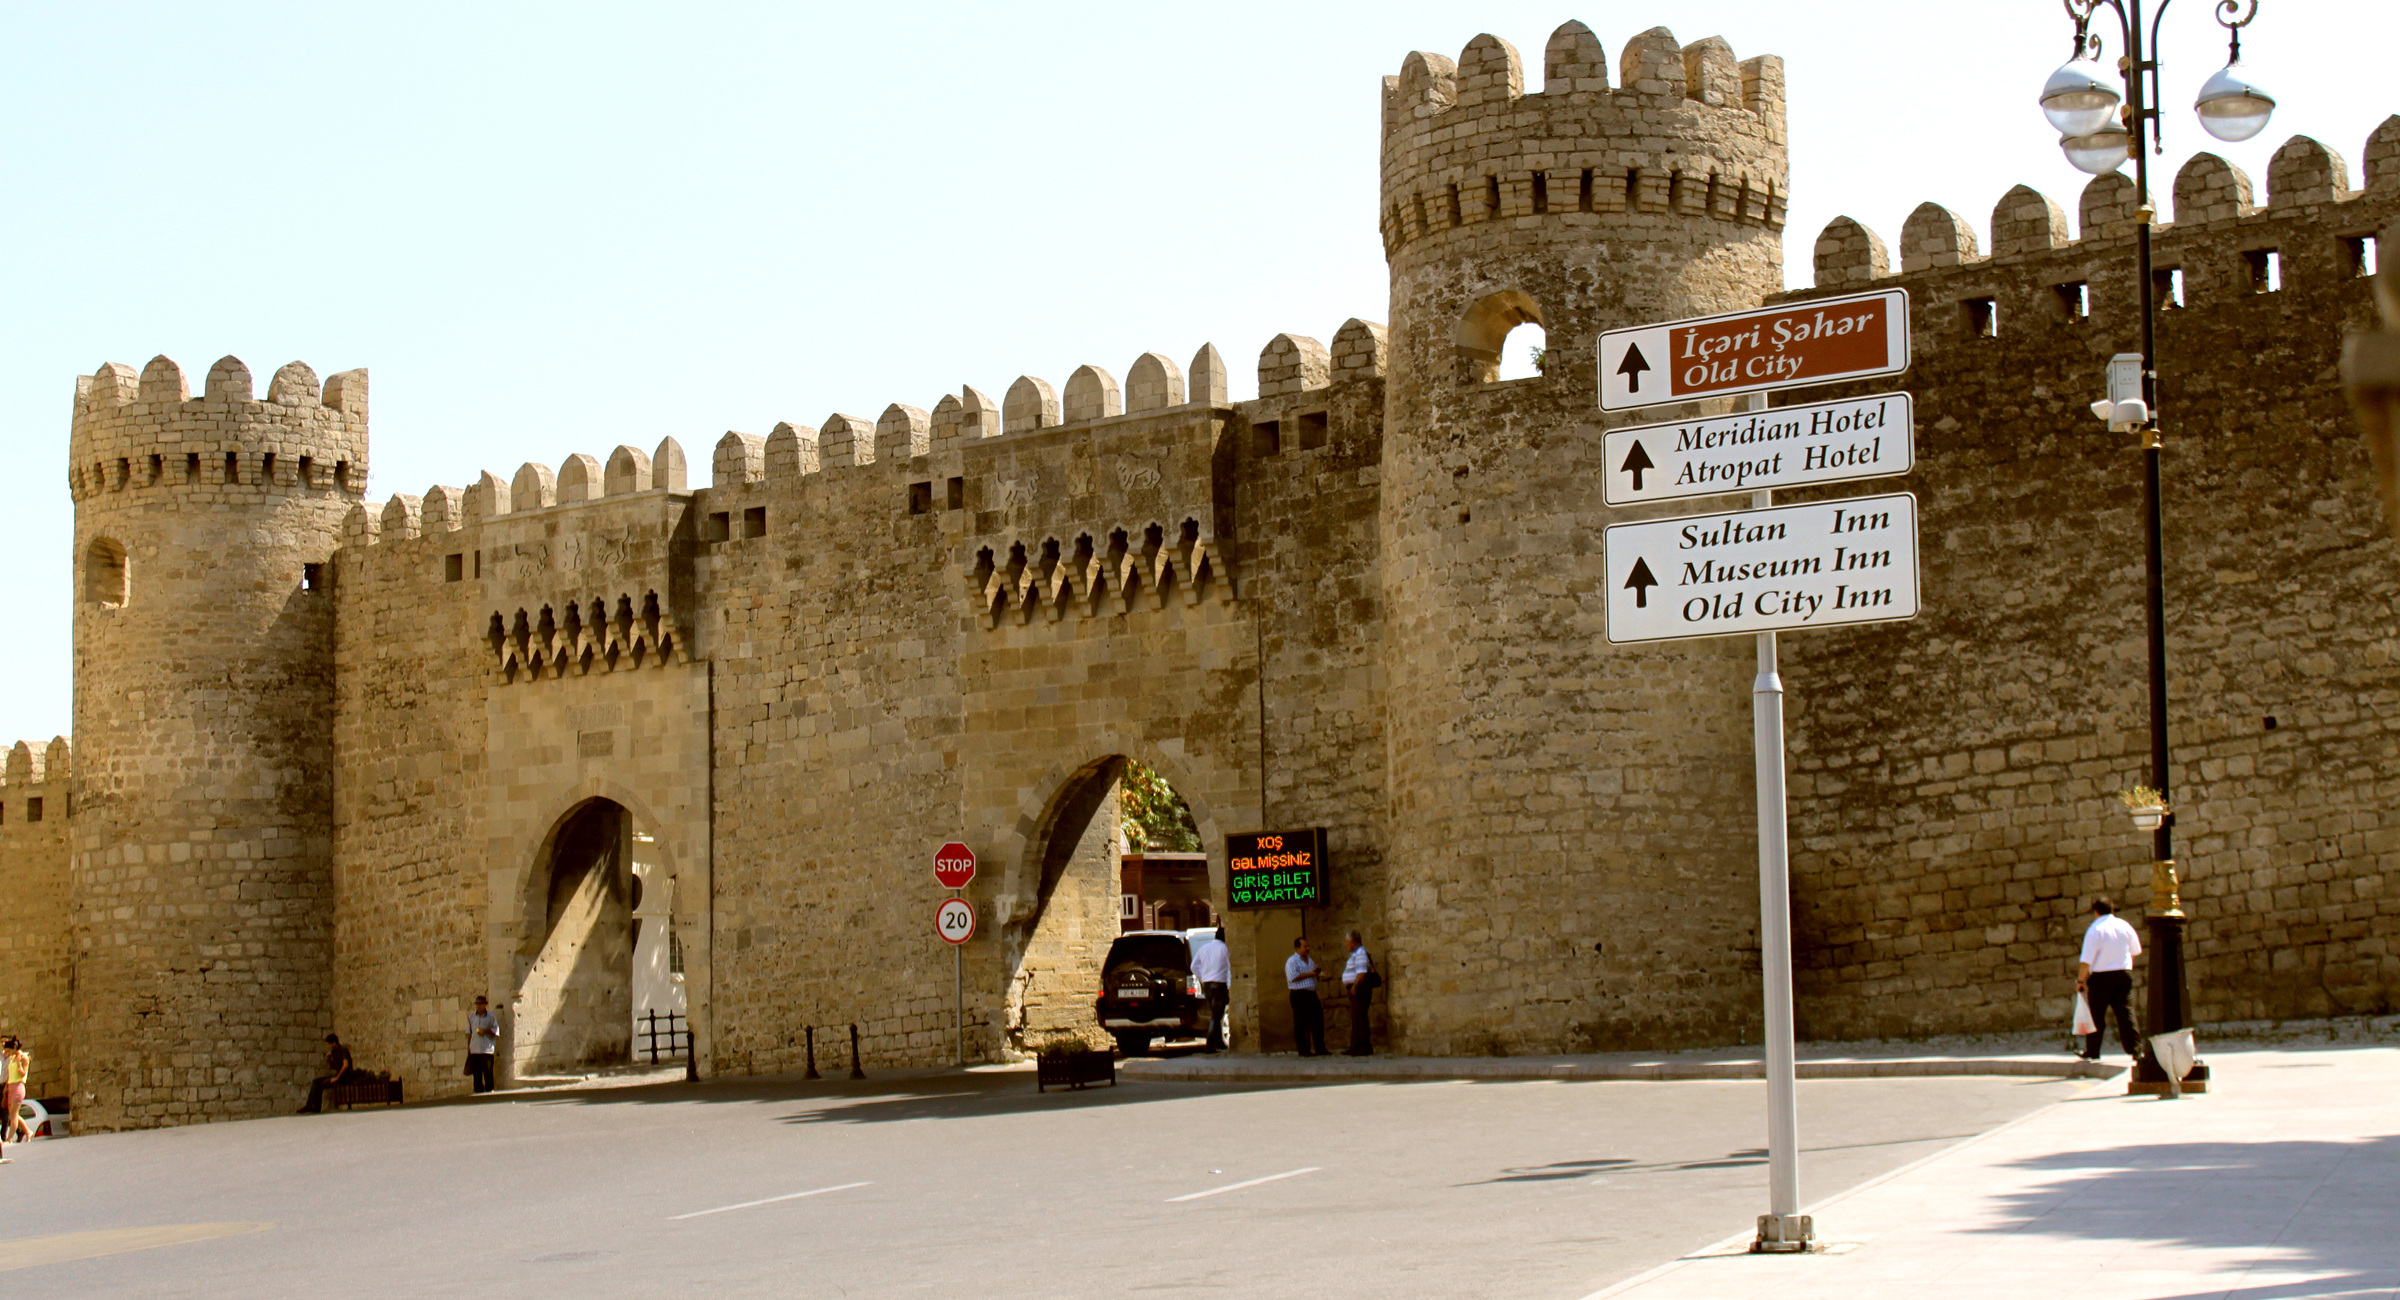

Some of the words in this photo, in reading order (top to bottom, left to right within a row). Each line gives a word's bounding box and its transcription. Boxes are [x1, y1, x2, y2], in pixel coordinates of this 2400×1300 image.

[1681, 328, 1760, 363] İçəri
[1771, 311, 1874, 352] Şəhər
[1684, 359, 1738, 387] Old
[1746, 354, 1803, 380] City
[1674, 418, 1800, 452] Meridian
[1808, 401, 1887, 436] Hotel
[1675, 452, 1783, 487] Atropat
[1802, 437, 1880, 471] Hotel
[1679, 519, 1787, 550] Sultan
[1830, 509, 1890, 534] Inn
[1678, 556, 1822, 586] Museum
[1831, 547, 1891, 572] Inn
[1682, 592, 1743, 622] Old
[1754, 590, 1823, 621] City
[1832, 585, 1892, 609] Inn
[1257, 836, 1283, 851] XOŞ
[937, 859, 972, 872] STOP
[1233, 873, 1270, 889] GİRİŞ
[1273, 871, 1311, 886] BİLET
[1231, 891, 1252, 903] VƏ
[1255, 887, 1315, 902] KARTLA!
[945, 912, 967, 929] 20
